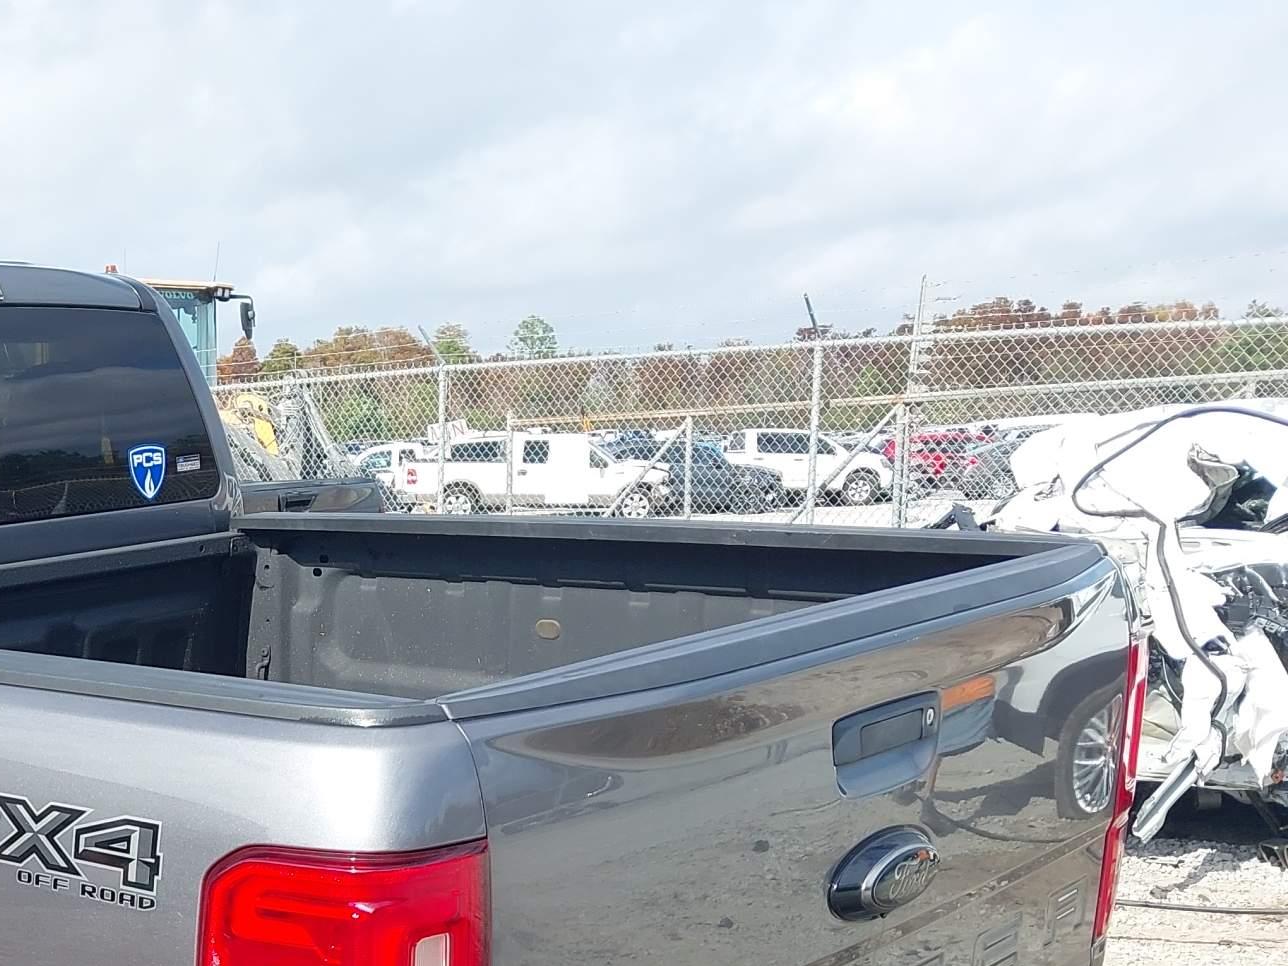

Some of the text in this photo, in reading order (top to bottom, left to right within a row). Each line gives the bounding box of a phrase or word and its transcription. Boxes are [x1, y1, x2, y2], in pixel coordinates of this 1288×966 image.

[132, 452, 162, 468] PCS
[16, 868, 158, 912] OFF ROAD
